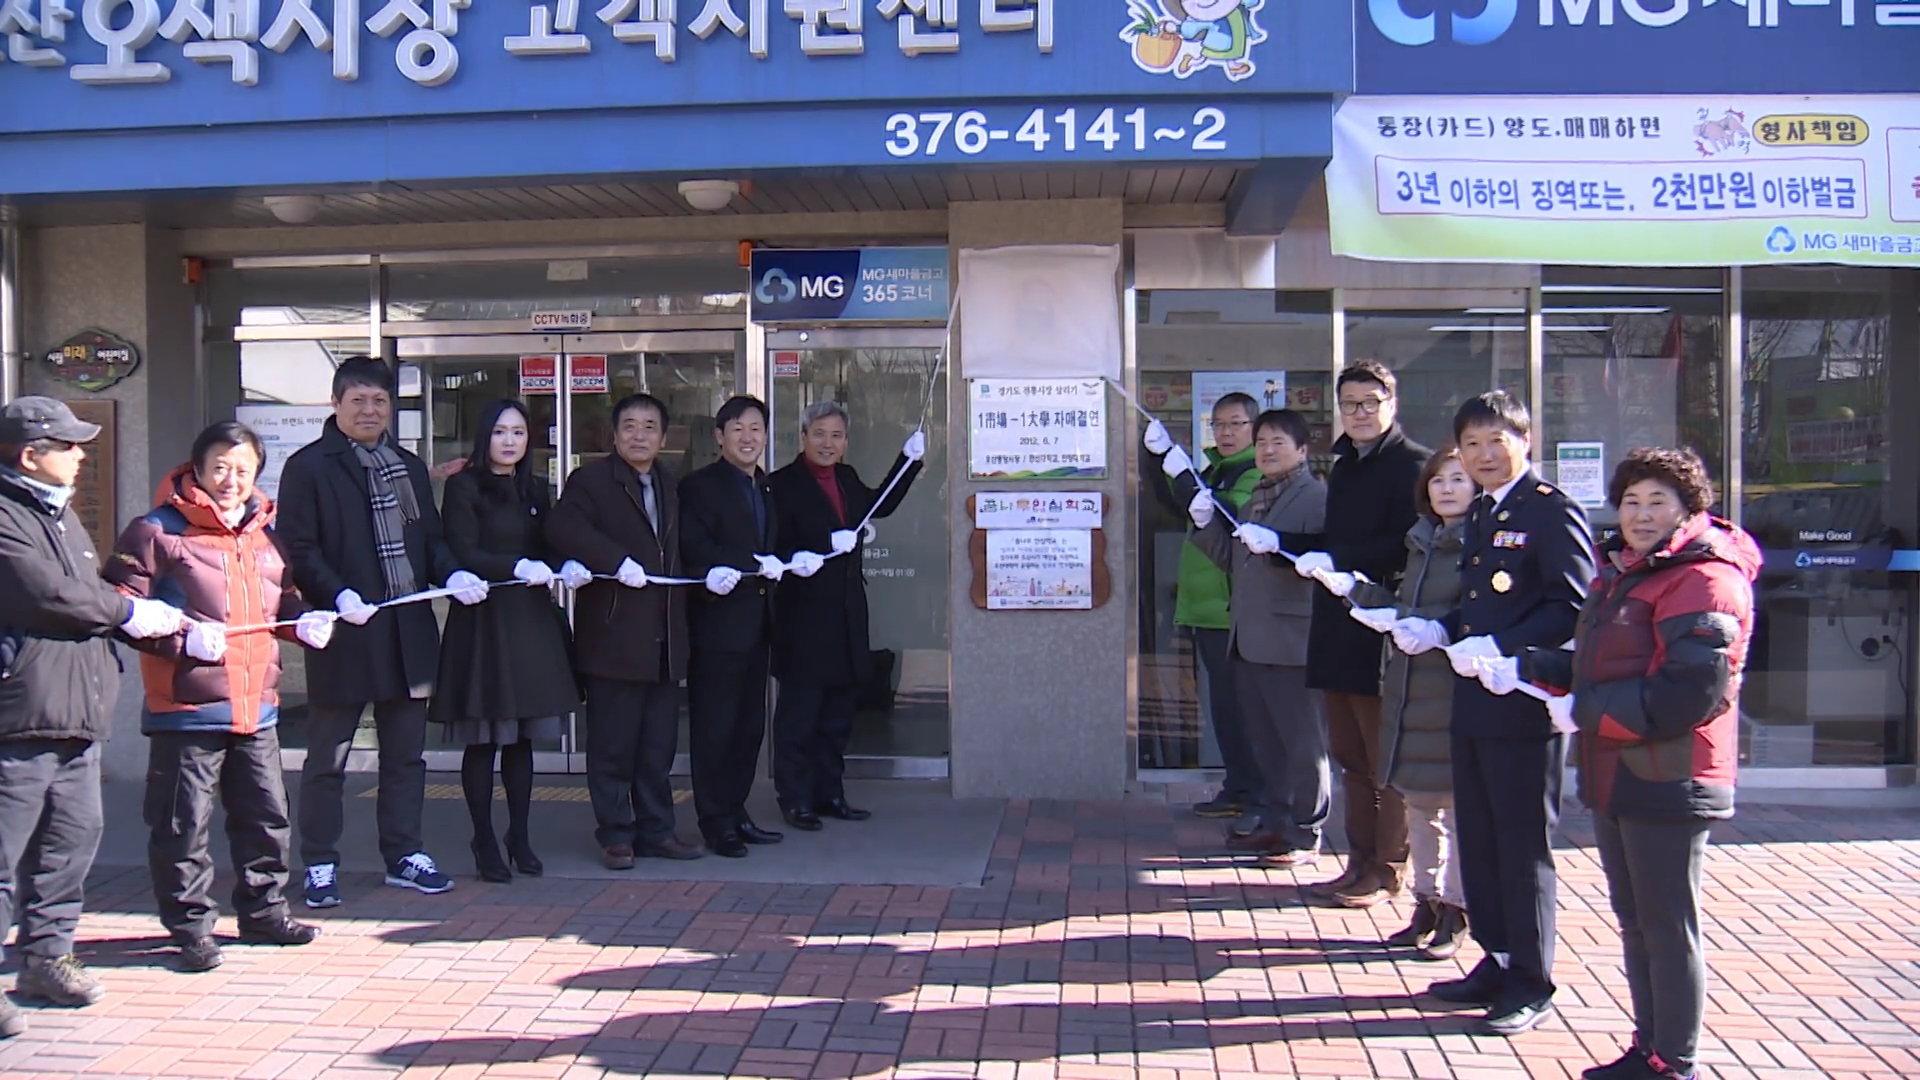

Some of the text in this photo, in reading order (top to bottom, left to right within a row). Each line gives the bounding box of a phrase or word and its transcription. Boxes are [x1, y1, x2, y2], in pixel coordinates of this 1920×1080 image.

[885, 107, 1226, 156] 376-4141~2
[1377, 115, 1495, 139] 통장(카드)
[1760, 120, 1857, 142] 형사책임
[1396, 171, 1441, 205] 3년
[1450, 177, 1520, 210] 이하의
[1651, 171, 1757, 211] 2천만원
[1763, 176, 1856, 209] 이하벌금
[801, 276, 844, 298] MG
[863, 285, 932, 302] 365 코너
[1799, 530, 1852, 541] Make Good
